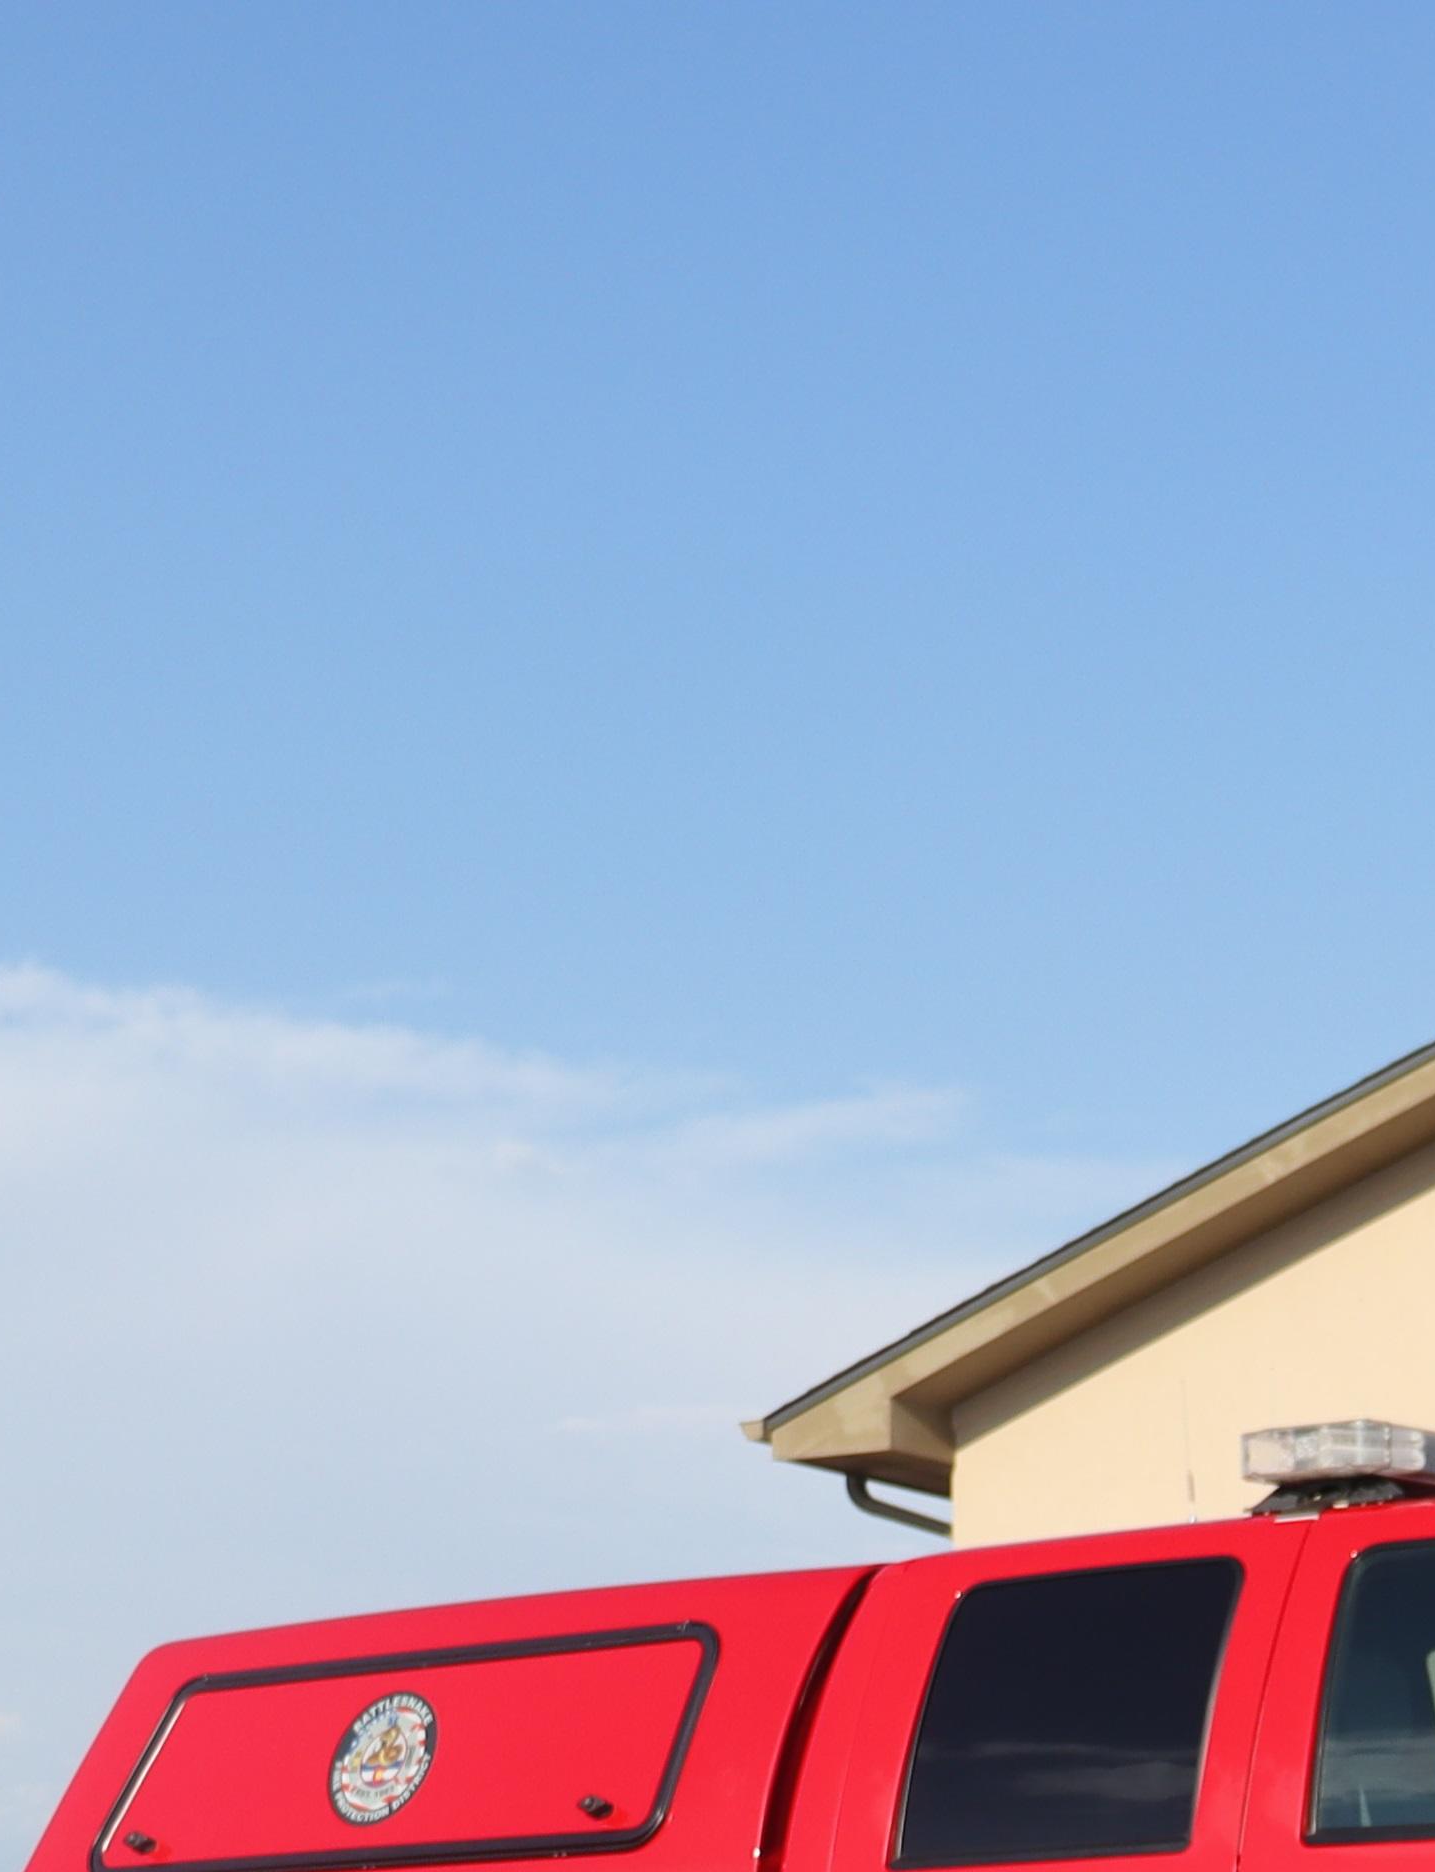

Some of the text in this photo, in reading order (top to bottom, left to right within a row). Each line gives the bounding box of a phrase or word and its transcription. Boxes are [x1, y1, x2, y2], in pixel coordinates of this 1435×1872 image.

[353, 1694, 434, 1734] RATTLESNAKE
[334, 1790, 391, 1822] PROTECTION
[391, 1753, 432, 1809] DISTRICT
